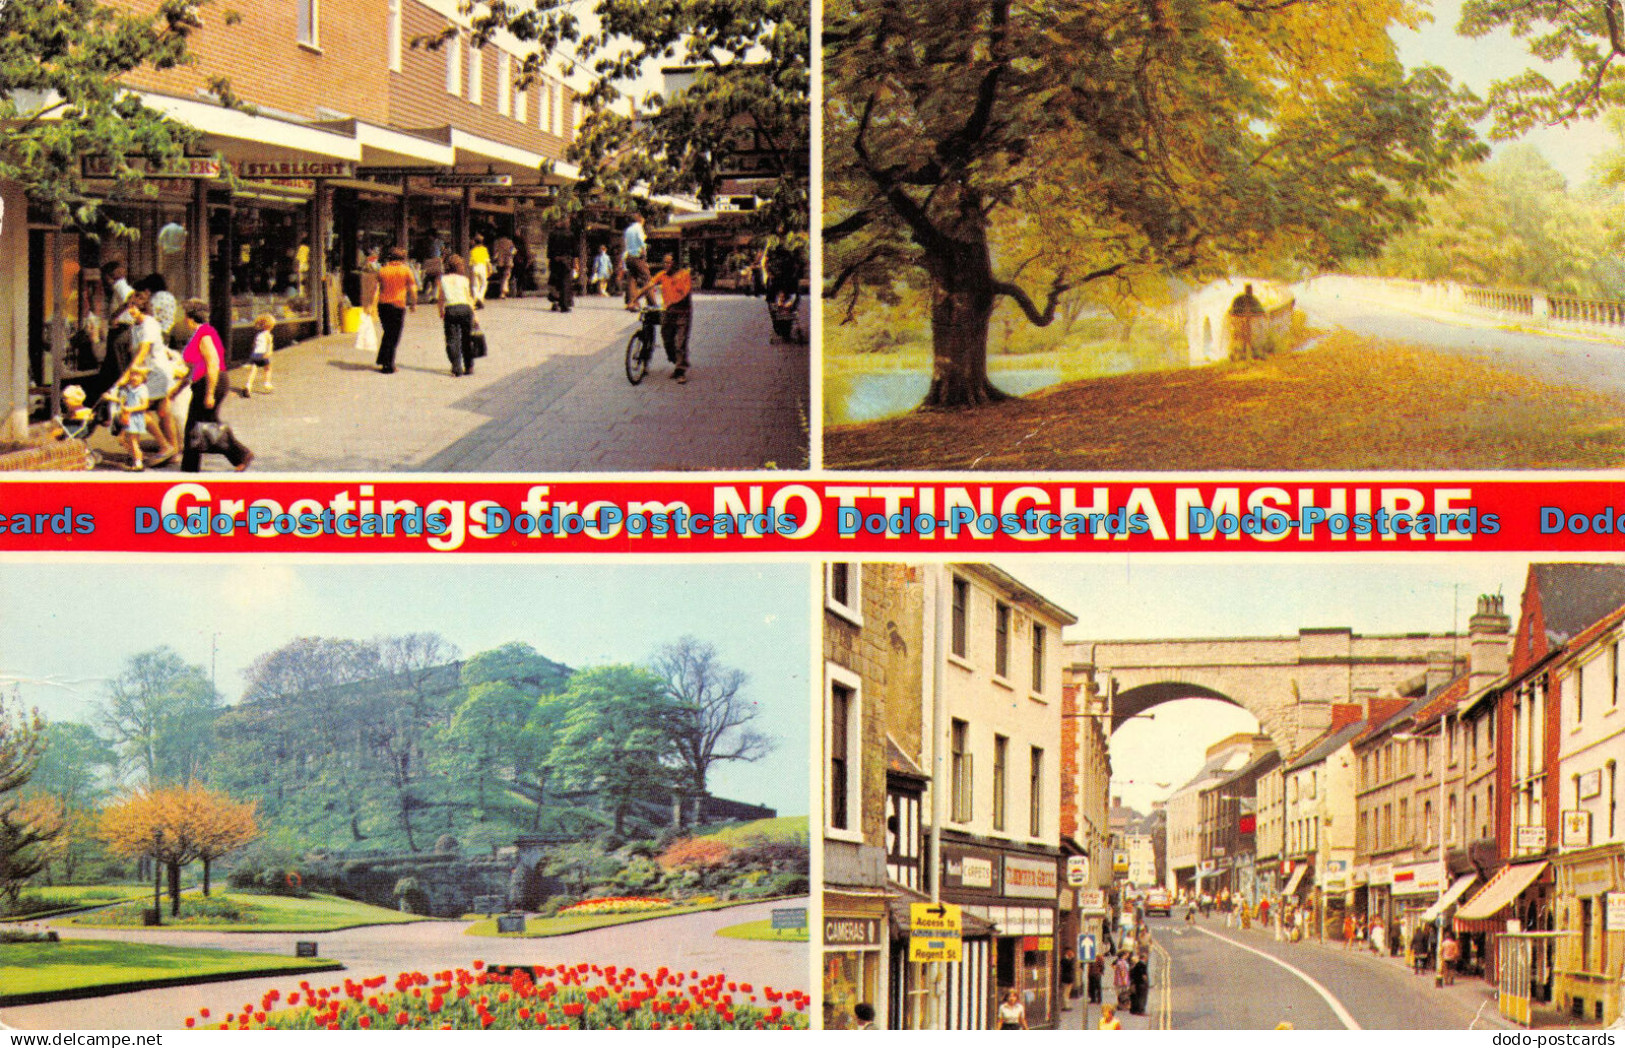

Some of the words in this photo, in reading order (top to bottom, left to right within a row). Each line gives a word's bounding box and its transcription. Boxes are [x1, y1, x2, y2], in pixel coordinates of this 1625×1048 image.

[248, 161, 345, 176] STARLIGHT
[161, 483, 501, 551] Greetings
[521, 485, 692, 540] from
[712, 483, 1474, 542] NOTTINGHAMSHIRE
[916, 918, 944, 928] Access
[947, 919, 955, 928] to
[826, 921, 865, 941] CAMERAS
[915, 949, 944, 960] Regent
[946, 950, 956, 959] St
